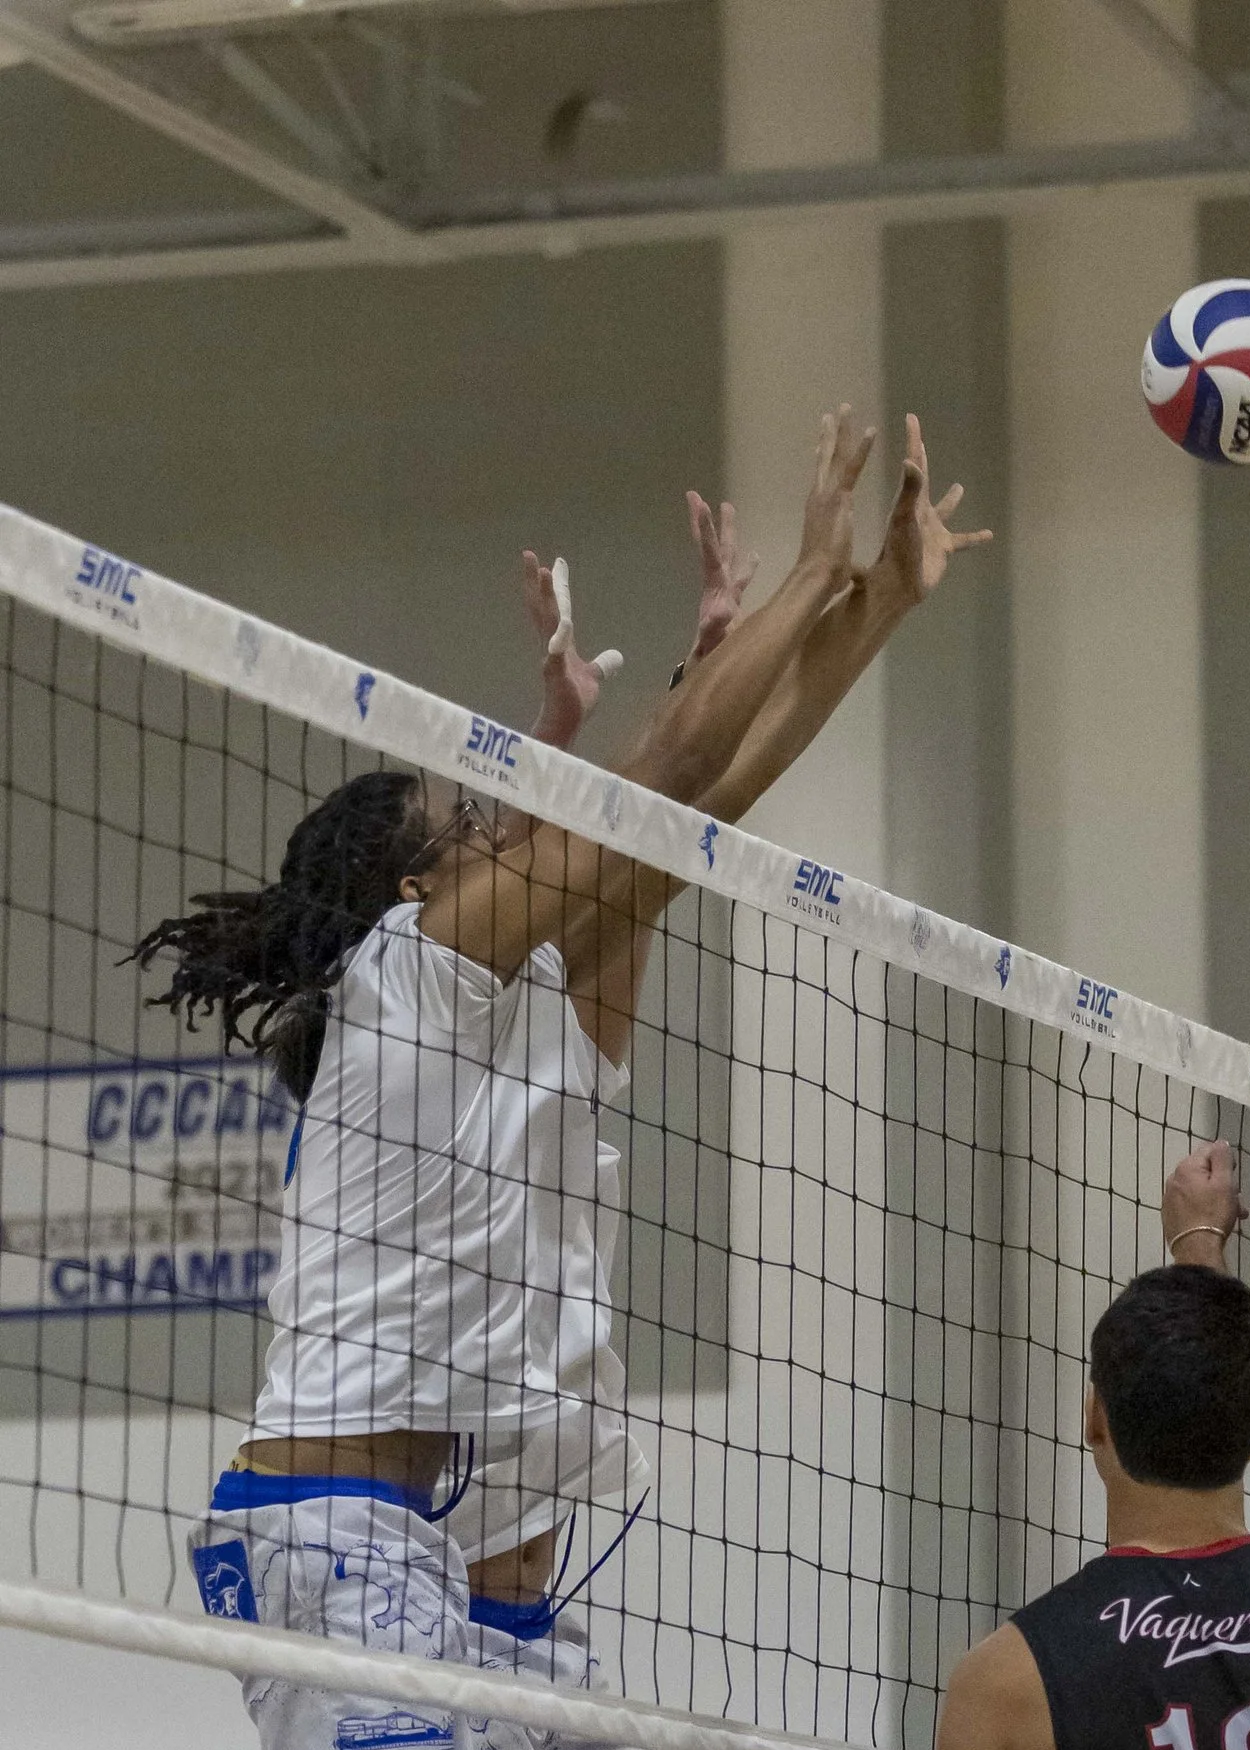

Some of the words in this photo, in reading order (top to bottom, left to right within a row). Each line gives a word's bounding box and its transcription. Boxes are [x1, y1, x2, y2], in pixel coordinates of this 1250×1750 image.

[76, 545, 143, 605] SMC
[466, 715, 522, 768] SMC
[793, 857, 844, 906] SMC
[1076, 977, 1118, 1019] SMC
